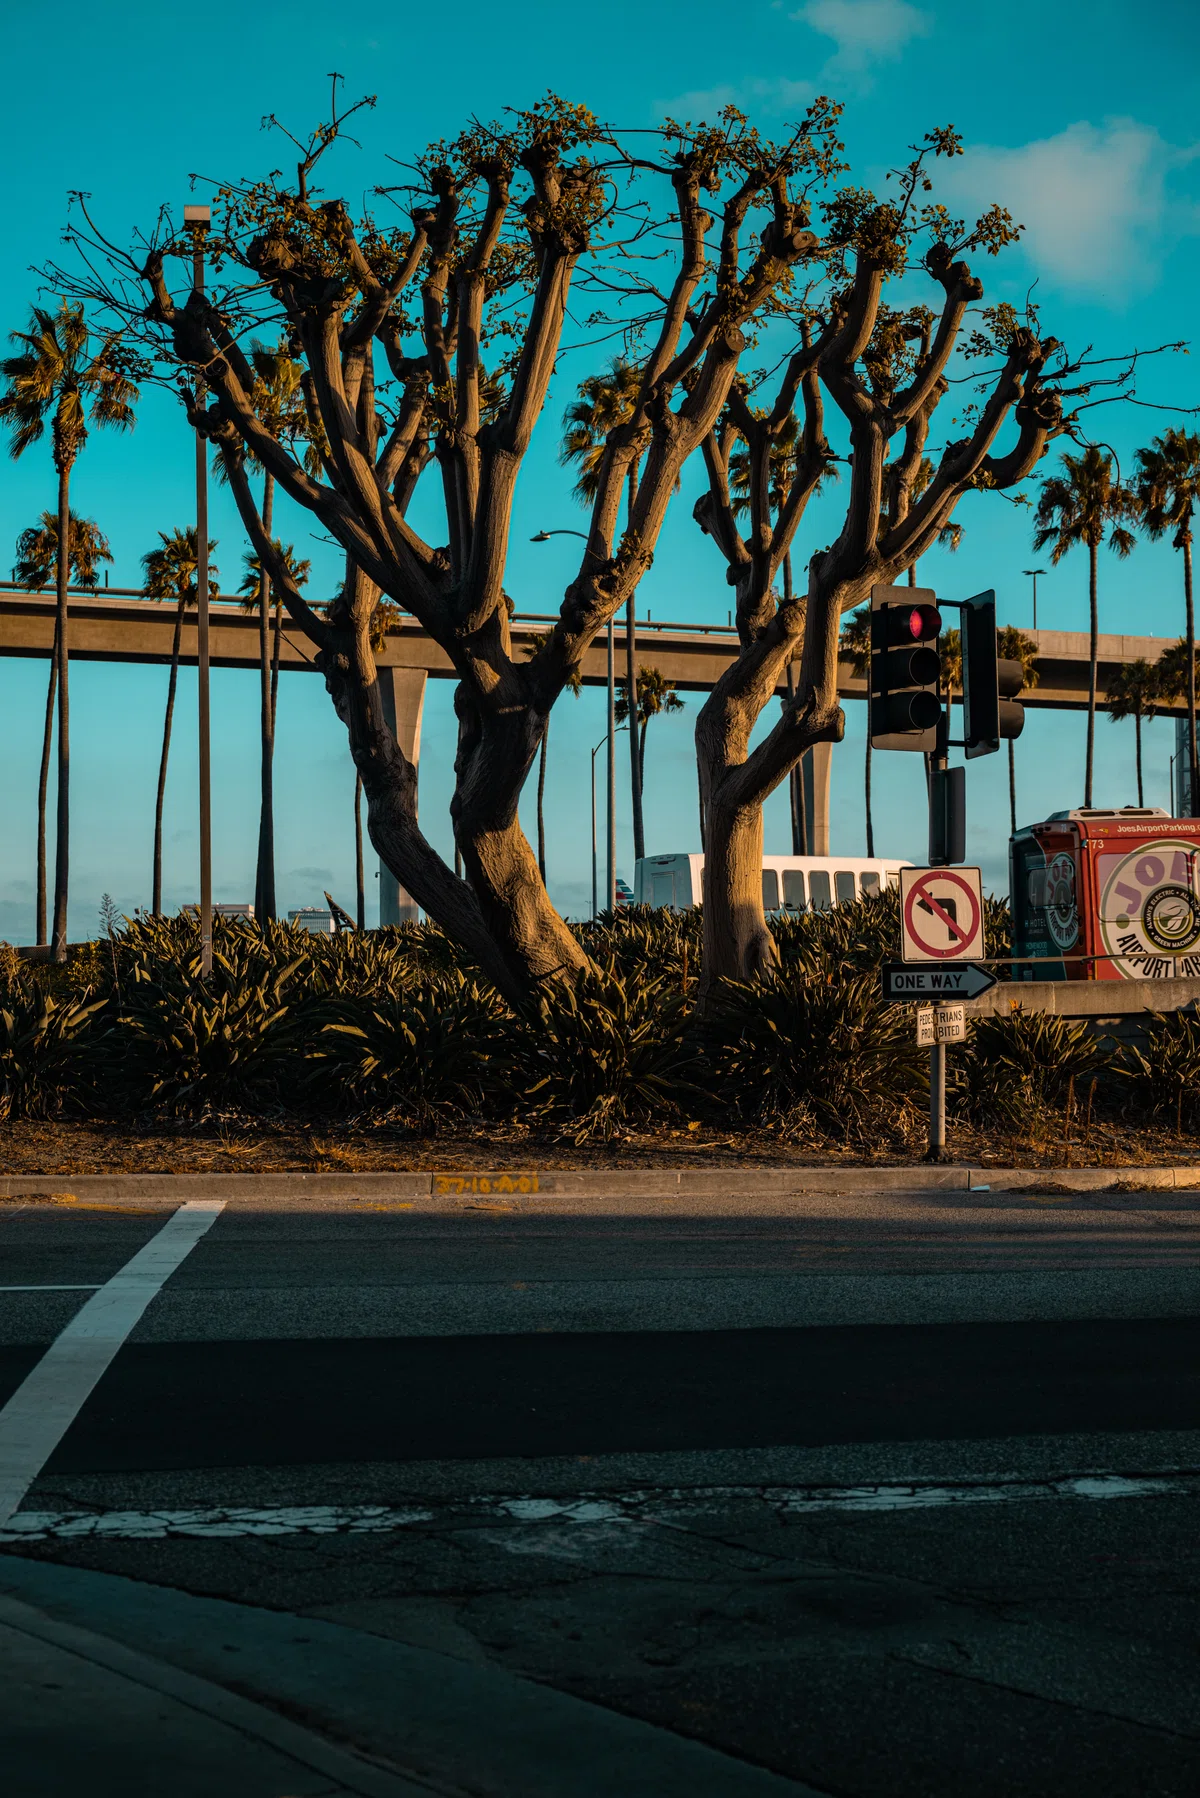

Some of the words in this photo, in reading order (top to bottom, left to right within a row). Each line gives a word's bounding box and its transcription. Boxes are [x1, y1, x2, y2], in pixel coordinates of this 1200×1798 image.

[1091, 839, 1104, 849] 73
[1146, 906, 1154, 929] ALWAYS
[1150, 890, 1175, 905] ELECTRIC
[1029, 918, 1047, 927] HOTEL
[1153, 935, 1171, 947] GREEN
[1171, 933, 1196, 948] MACHINE
[894, 974, 925, 989] ONE
[931, 973, 963, 988] WAY
[919, 1010, 963, 1026] PEDESTRIANS
